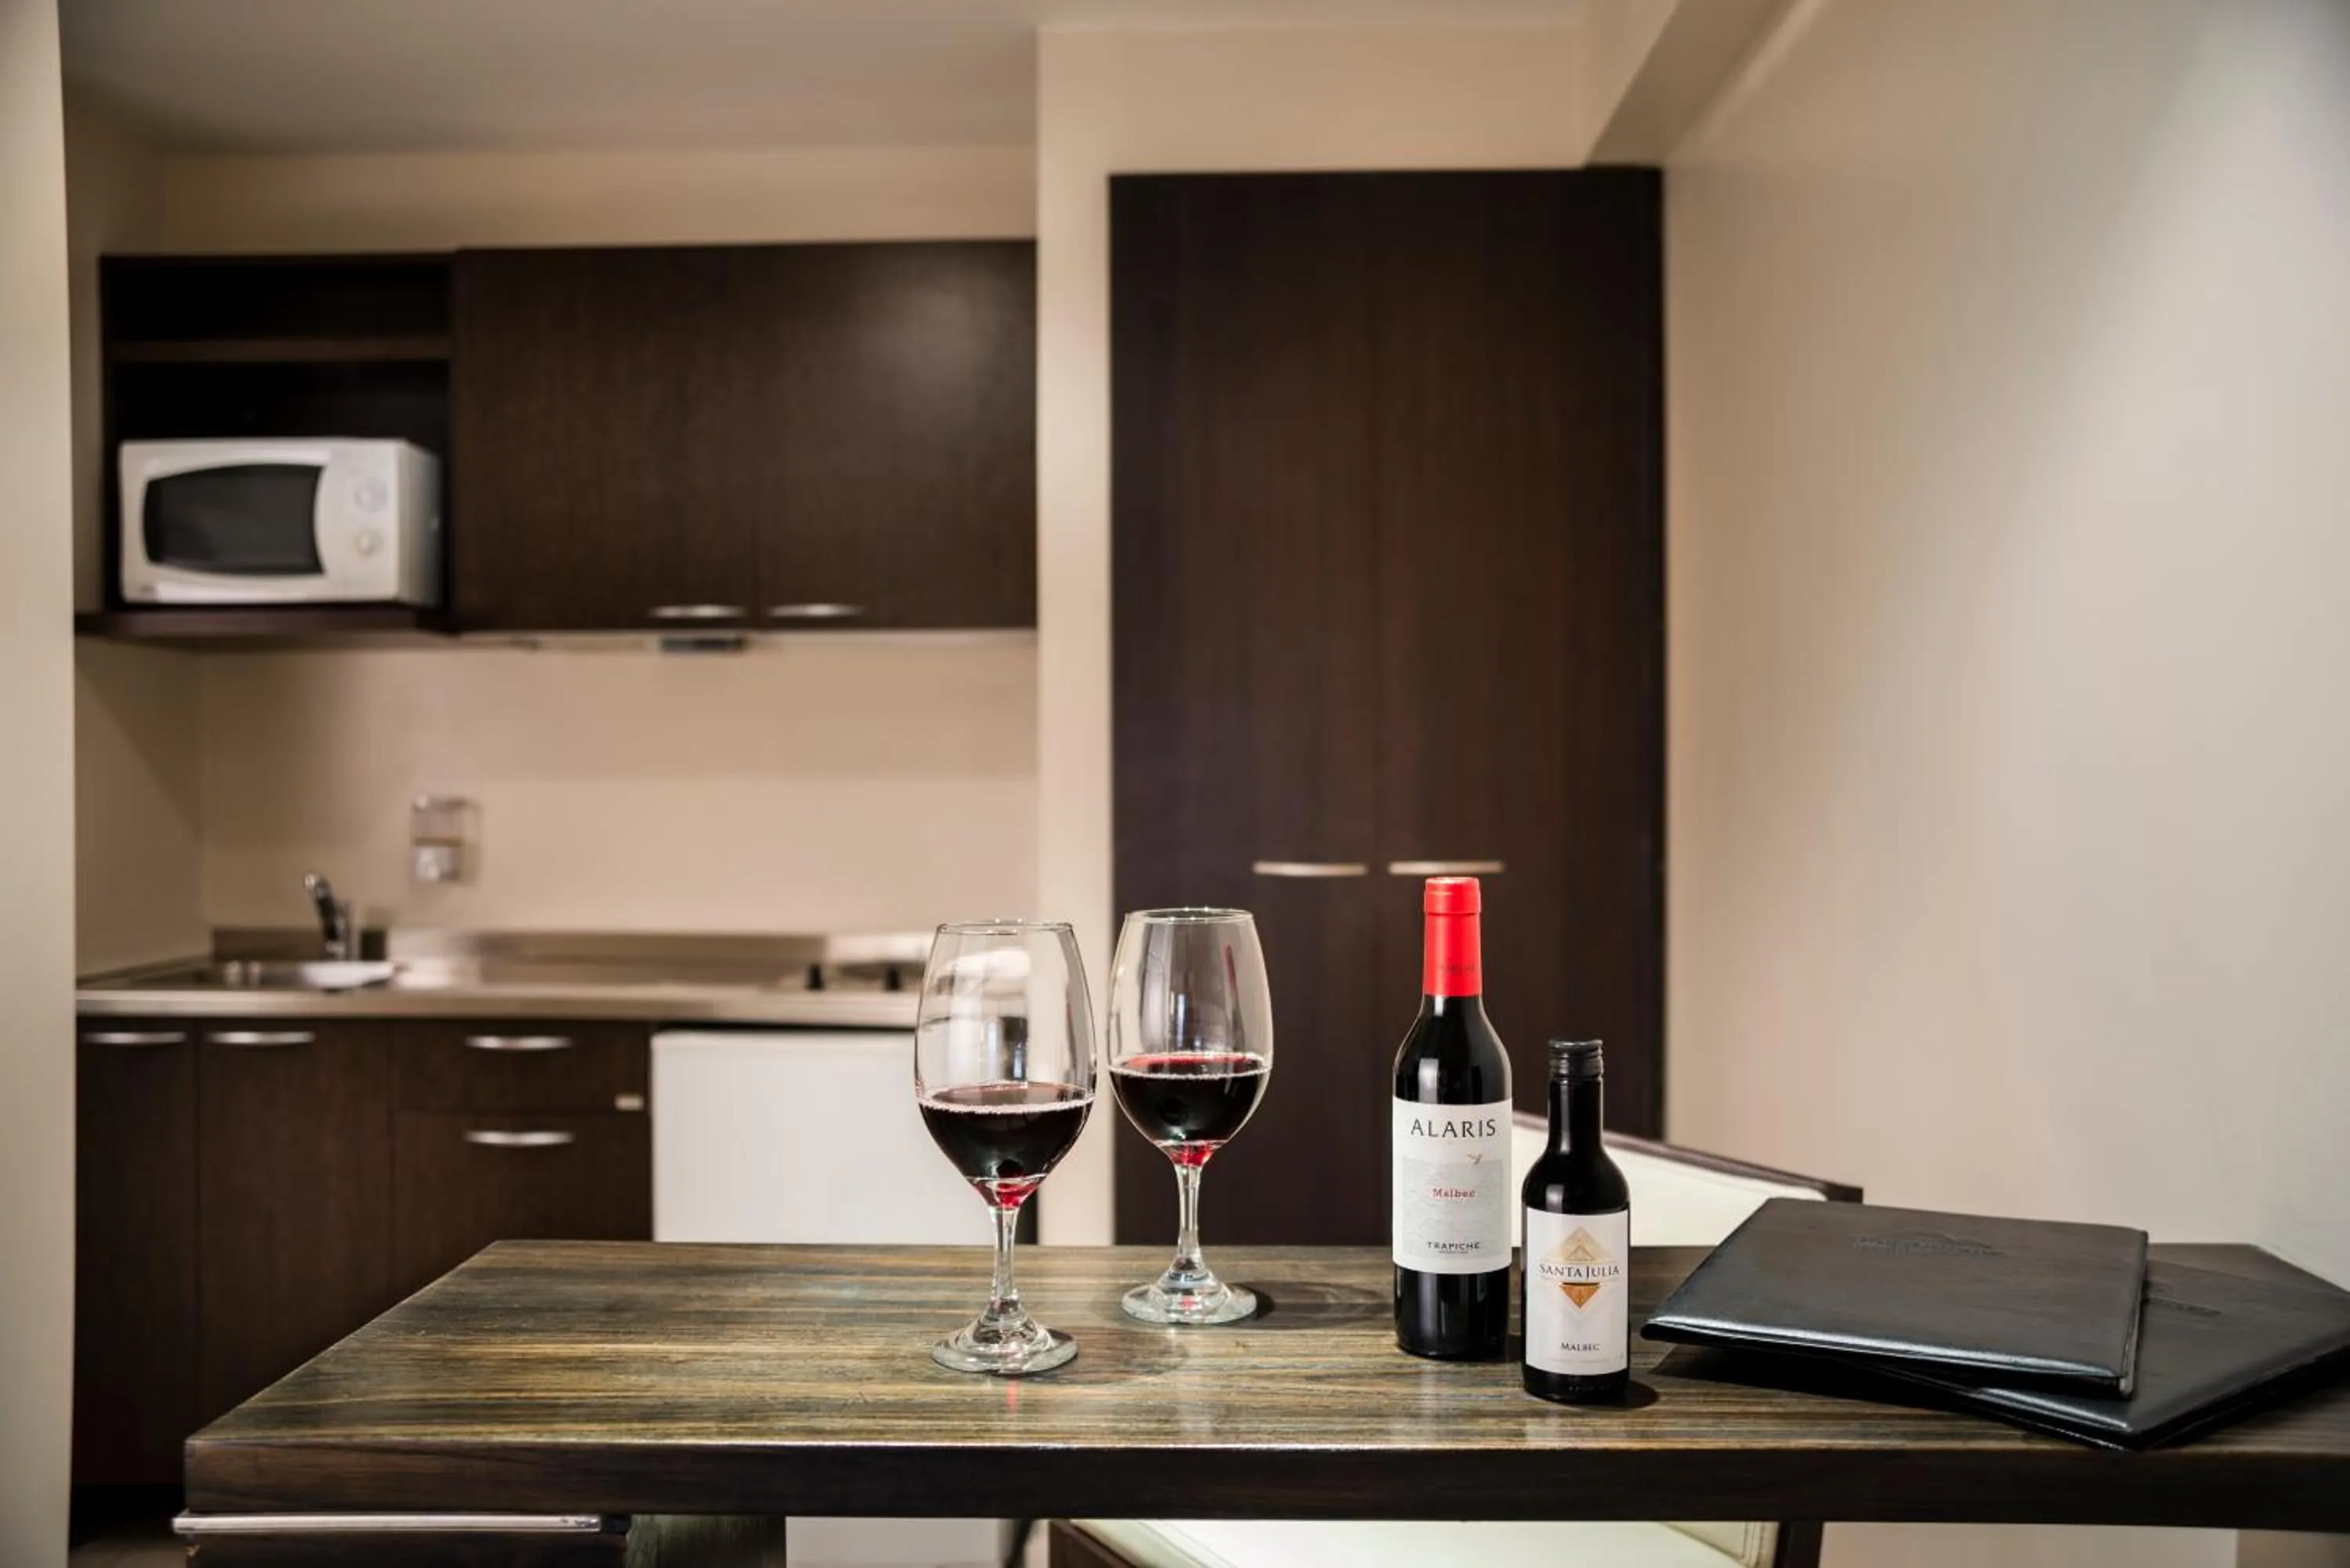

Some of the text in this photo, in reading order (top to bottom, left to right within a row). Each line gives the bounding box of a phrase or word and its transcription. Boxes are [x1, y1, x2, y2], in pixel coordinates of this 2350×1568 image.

[1411, 1119, 1496, 1138] ALARIS
[1432, 1188, 1476, 1198] Malbec
[1428, 1241, 1480, 1251] TRAPICHE
[1539, 1264, 1619, 1279] SANTA JULIA
[1561, 1342, 1601, 1351] MALBEC
